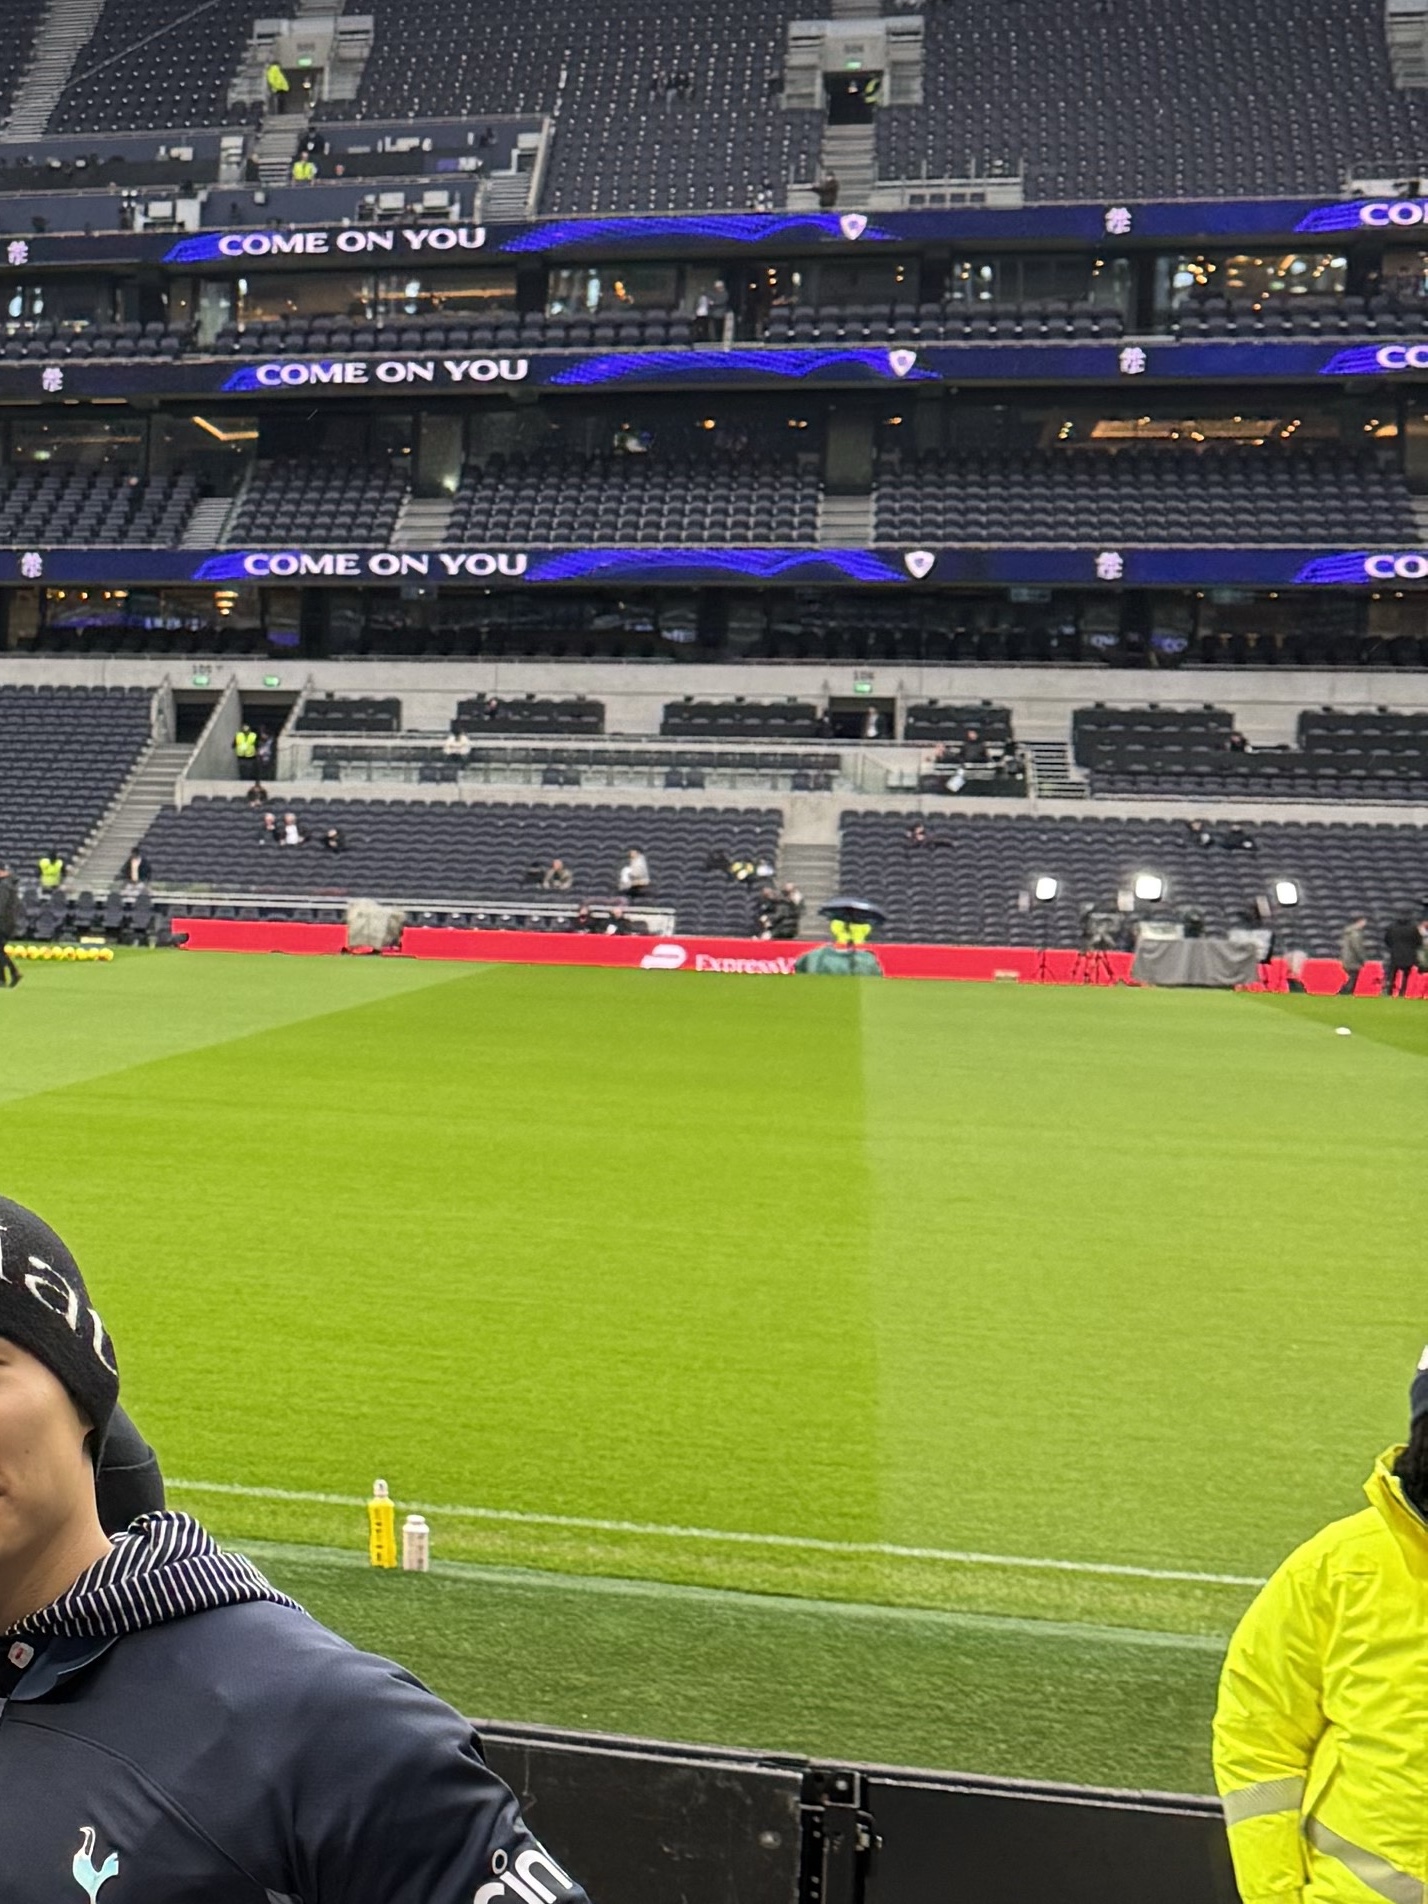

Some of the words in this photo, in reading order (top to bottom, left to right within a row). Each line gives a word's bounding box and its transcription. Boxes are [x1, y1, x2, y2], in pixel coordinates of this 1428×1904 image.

[1359, 201, 1428, 226] CO
[218, 233, 329, 257] COME
[336, 230, 393, 253] ON
[402, 226, 487, 251] YOU
[256, 362, 370, 386] COME
[376, 361, 435, 384] ON
[443, 359, 529, 382] YOU
[244, 552, 362, 576] COME
[368, 552, 429, 576] ON
[437, 552, 528, 577] YOU
